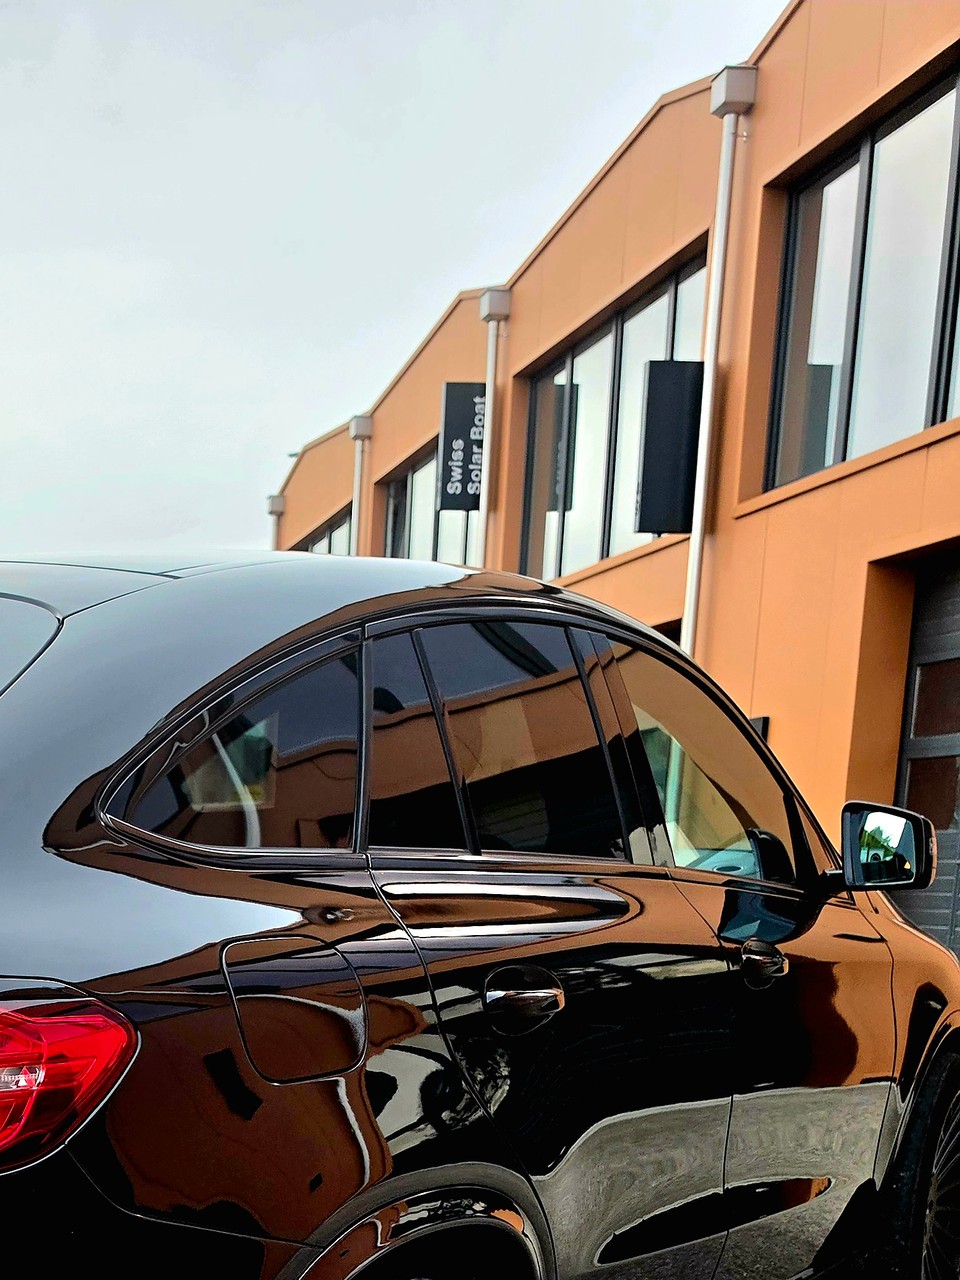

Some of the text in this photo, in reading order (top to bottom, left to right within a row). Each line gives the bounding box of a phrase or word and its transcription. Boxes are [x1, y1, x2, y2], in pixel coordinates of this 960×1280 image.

[446, 438, 464, 495] Swiss
[467, 395, 485, 495] Solar Boat
